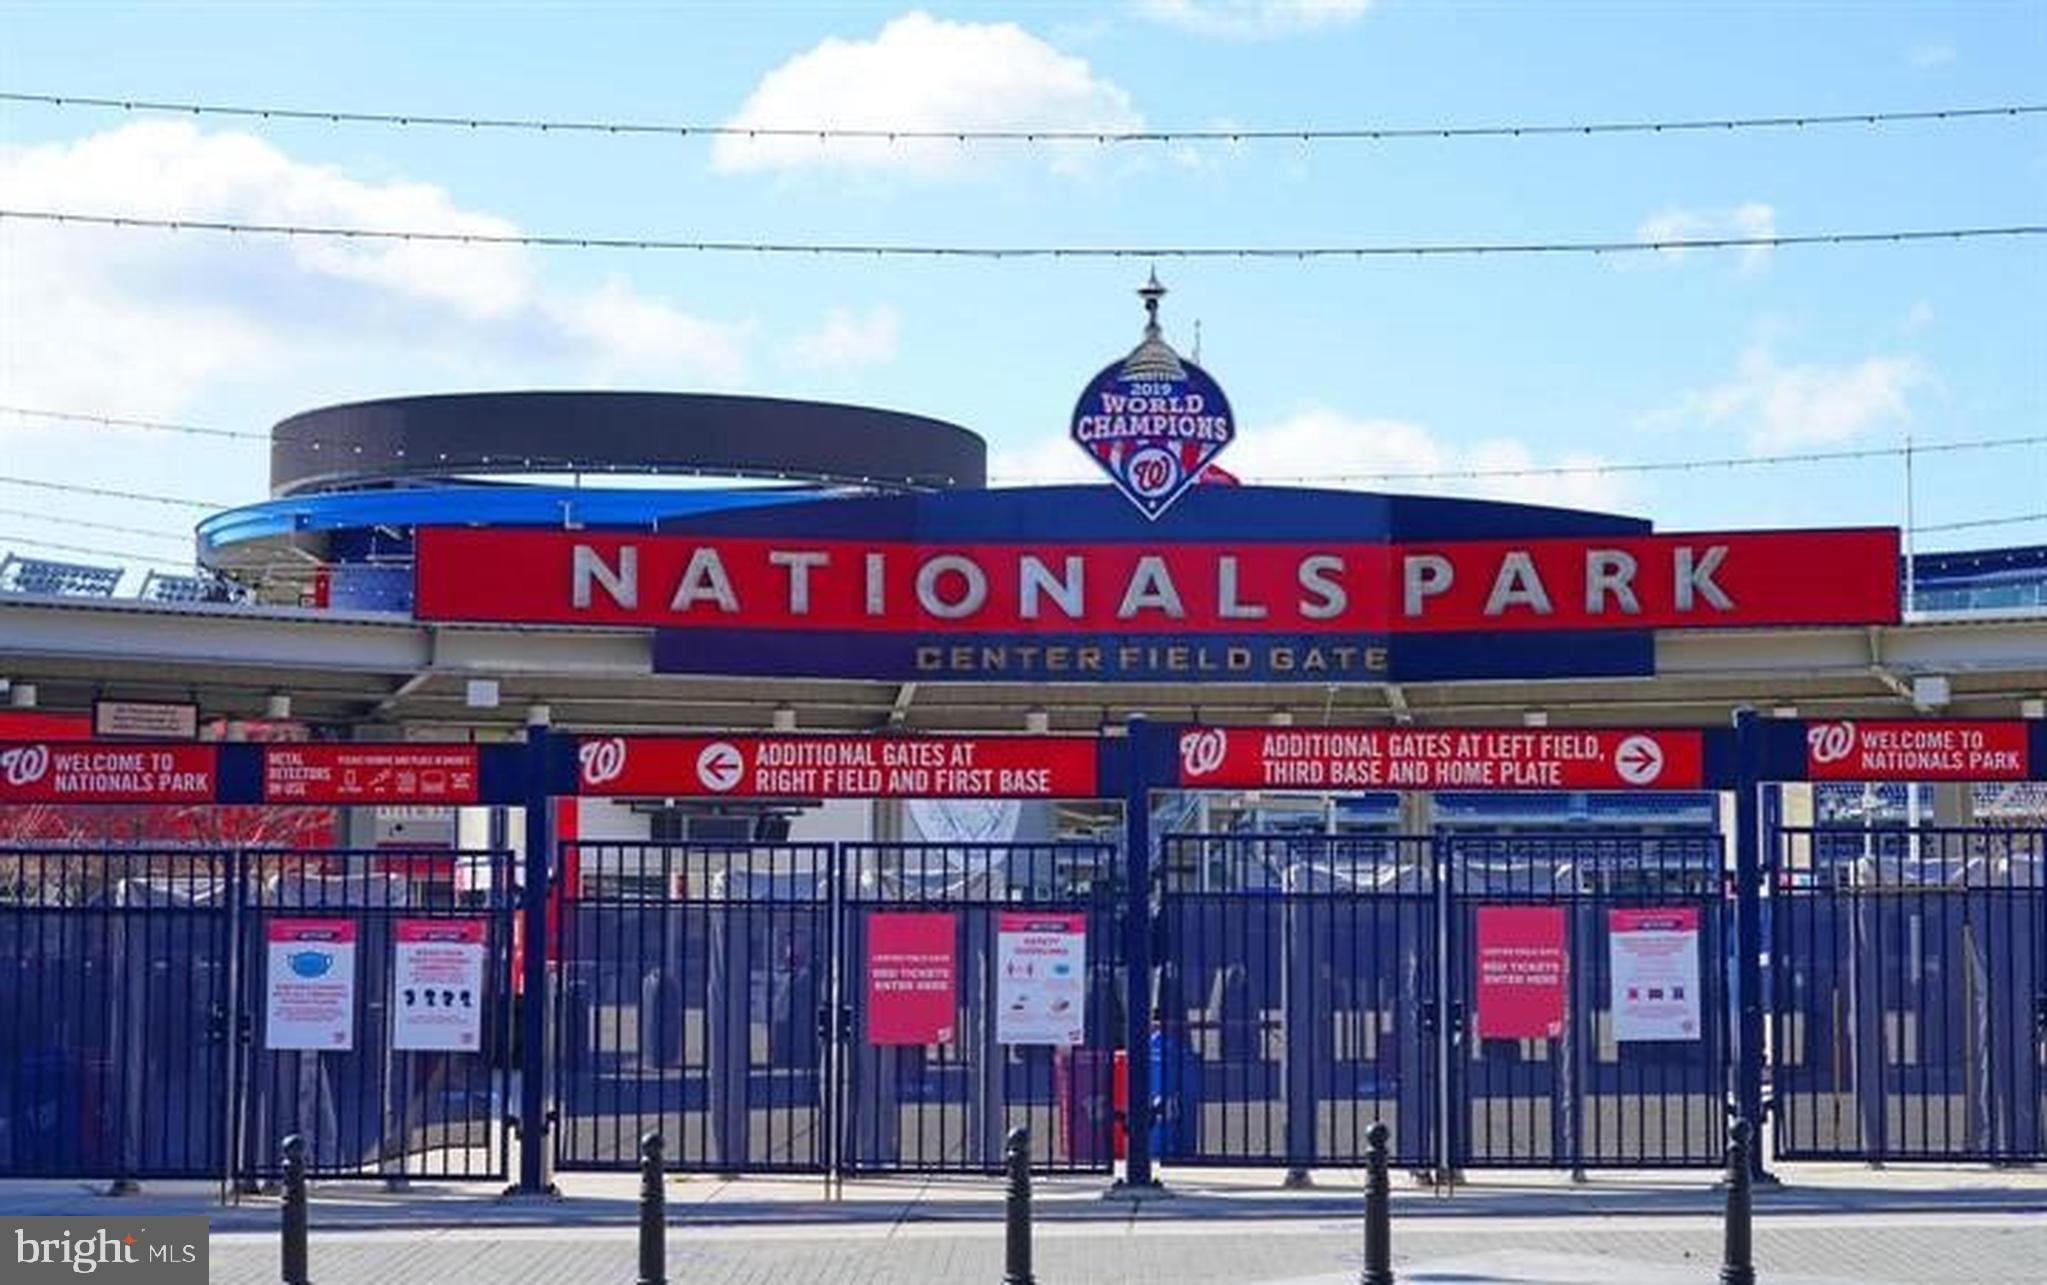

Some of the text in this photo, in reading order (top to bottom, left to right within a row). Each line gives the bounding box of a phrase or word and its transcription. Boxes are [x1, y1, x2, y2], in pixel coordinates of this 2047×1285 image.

[1130, 383, 1172, 396] 2019
[1101, 392, 1205, 415] WORLD
[1077, 414, 1229, 442] CHAMPIONS
[572, 544, 1735, 620] NATIONALS PARK
[916, 646, 1388, 671] CENTER FIELD GATE
[1262, 734, 1605, 762] ADDITIONAL GATES AT LEFT FIELD,
[1861, 730, 1984, 750] WELCOME TO
[53, 753, 174, 773] WELCOME TO
[756, 743, 976, 767] ADDITIONAL GATES AT
[1861, 751, 2021, 770] NATIONALS PARK
[54, 773, 209, 793] NATIONALS PARK
[756, 769, 1051, 793] RIGHT FIELD AND FIRST BASE
[1262, 760, 1562, 784] THIRD BASE AND HOME PLATE
